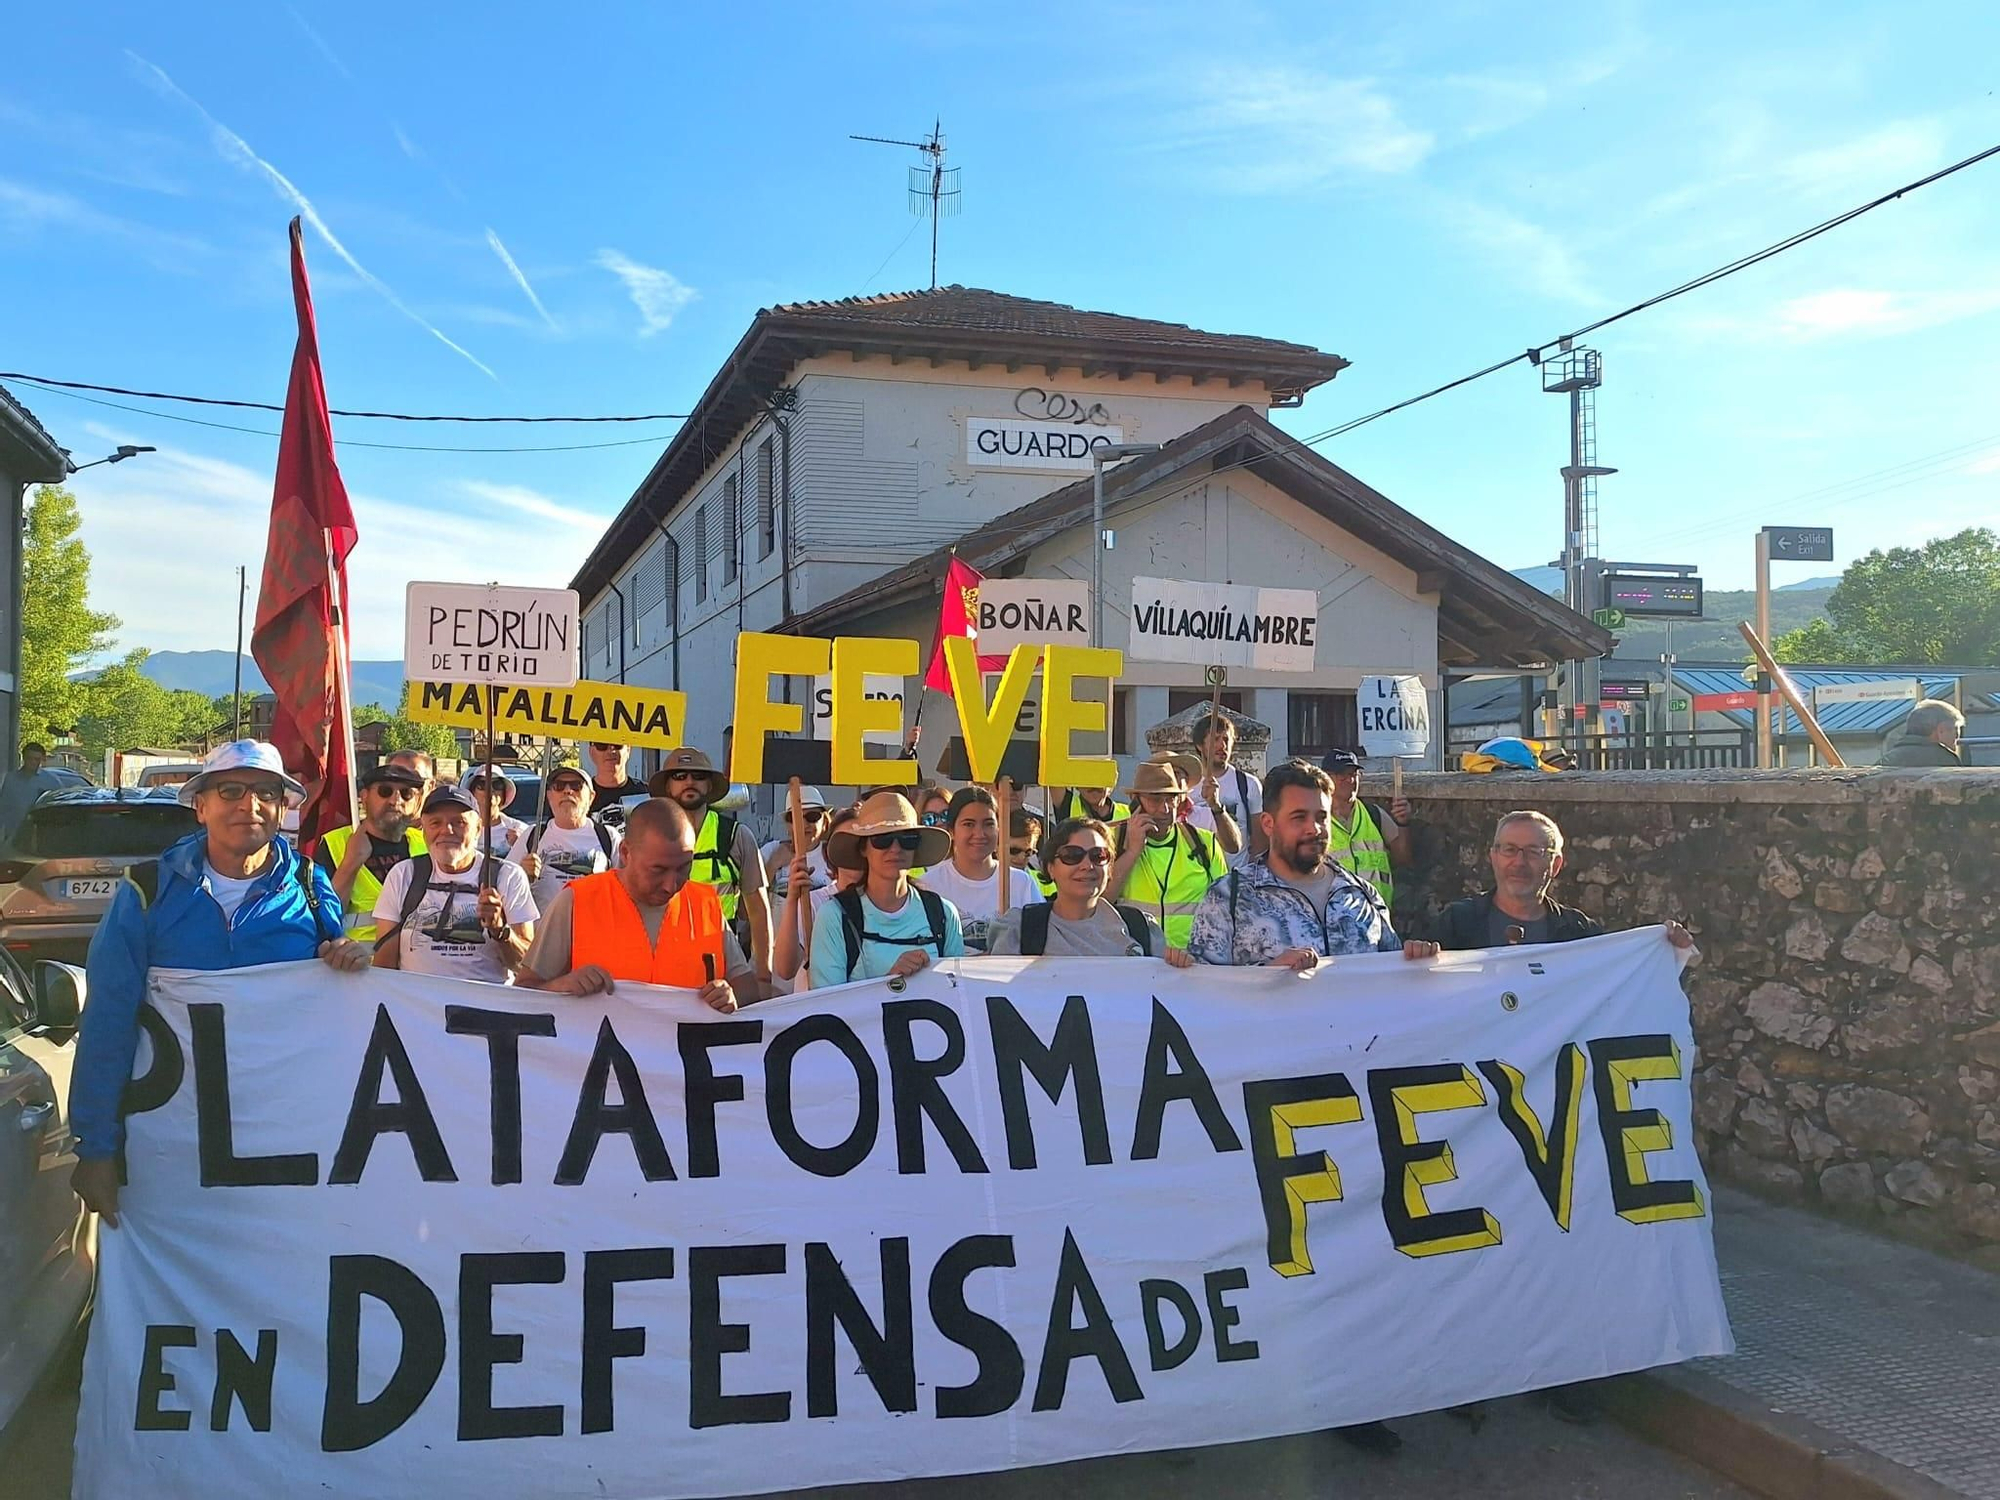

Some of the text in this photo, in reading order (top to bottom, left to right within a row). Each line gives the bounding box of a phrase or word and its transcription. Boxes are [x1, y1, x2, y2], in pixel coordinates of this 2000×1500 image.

[1797, 533, 1826, 544] Salida
[1798, 545, 1813, 555] Exit
[428, 600, 568, 652] PEDRÚN
[979, 599, 1087, 632] BOÑAR
[432, 653, 452, 670] DE
[1377, 679, 1400, 699] LA
[421, 682, 671, 736] MATALLANA
[730, 631, 1124, 788] FEVE
[72, 881, 110, 894] 6742
[117, 996, 1706, 1279] PLATAFORMA FEVE
[134, 1226, 1260, 1453] EN DEFENSA DE
